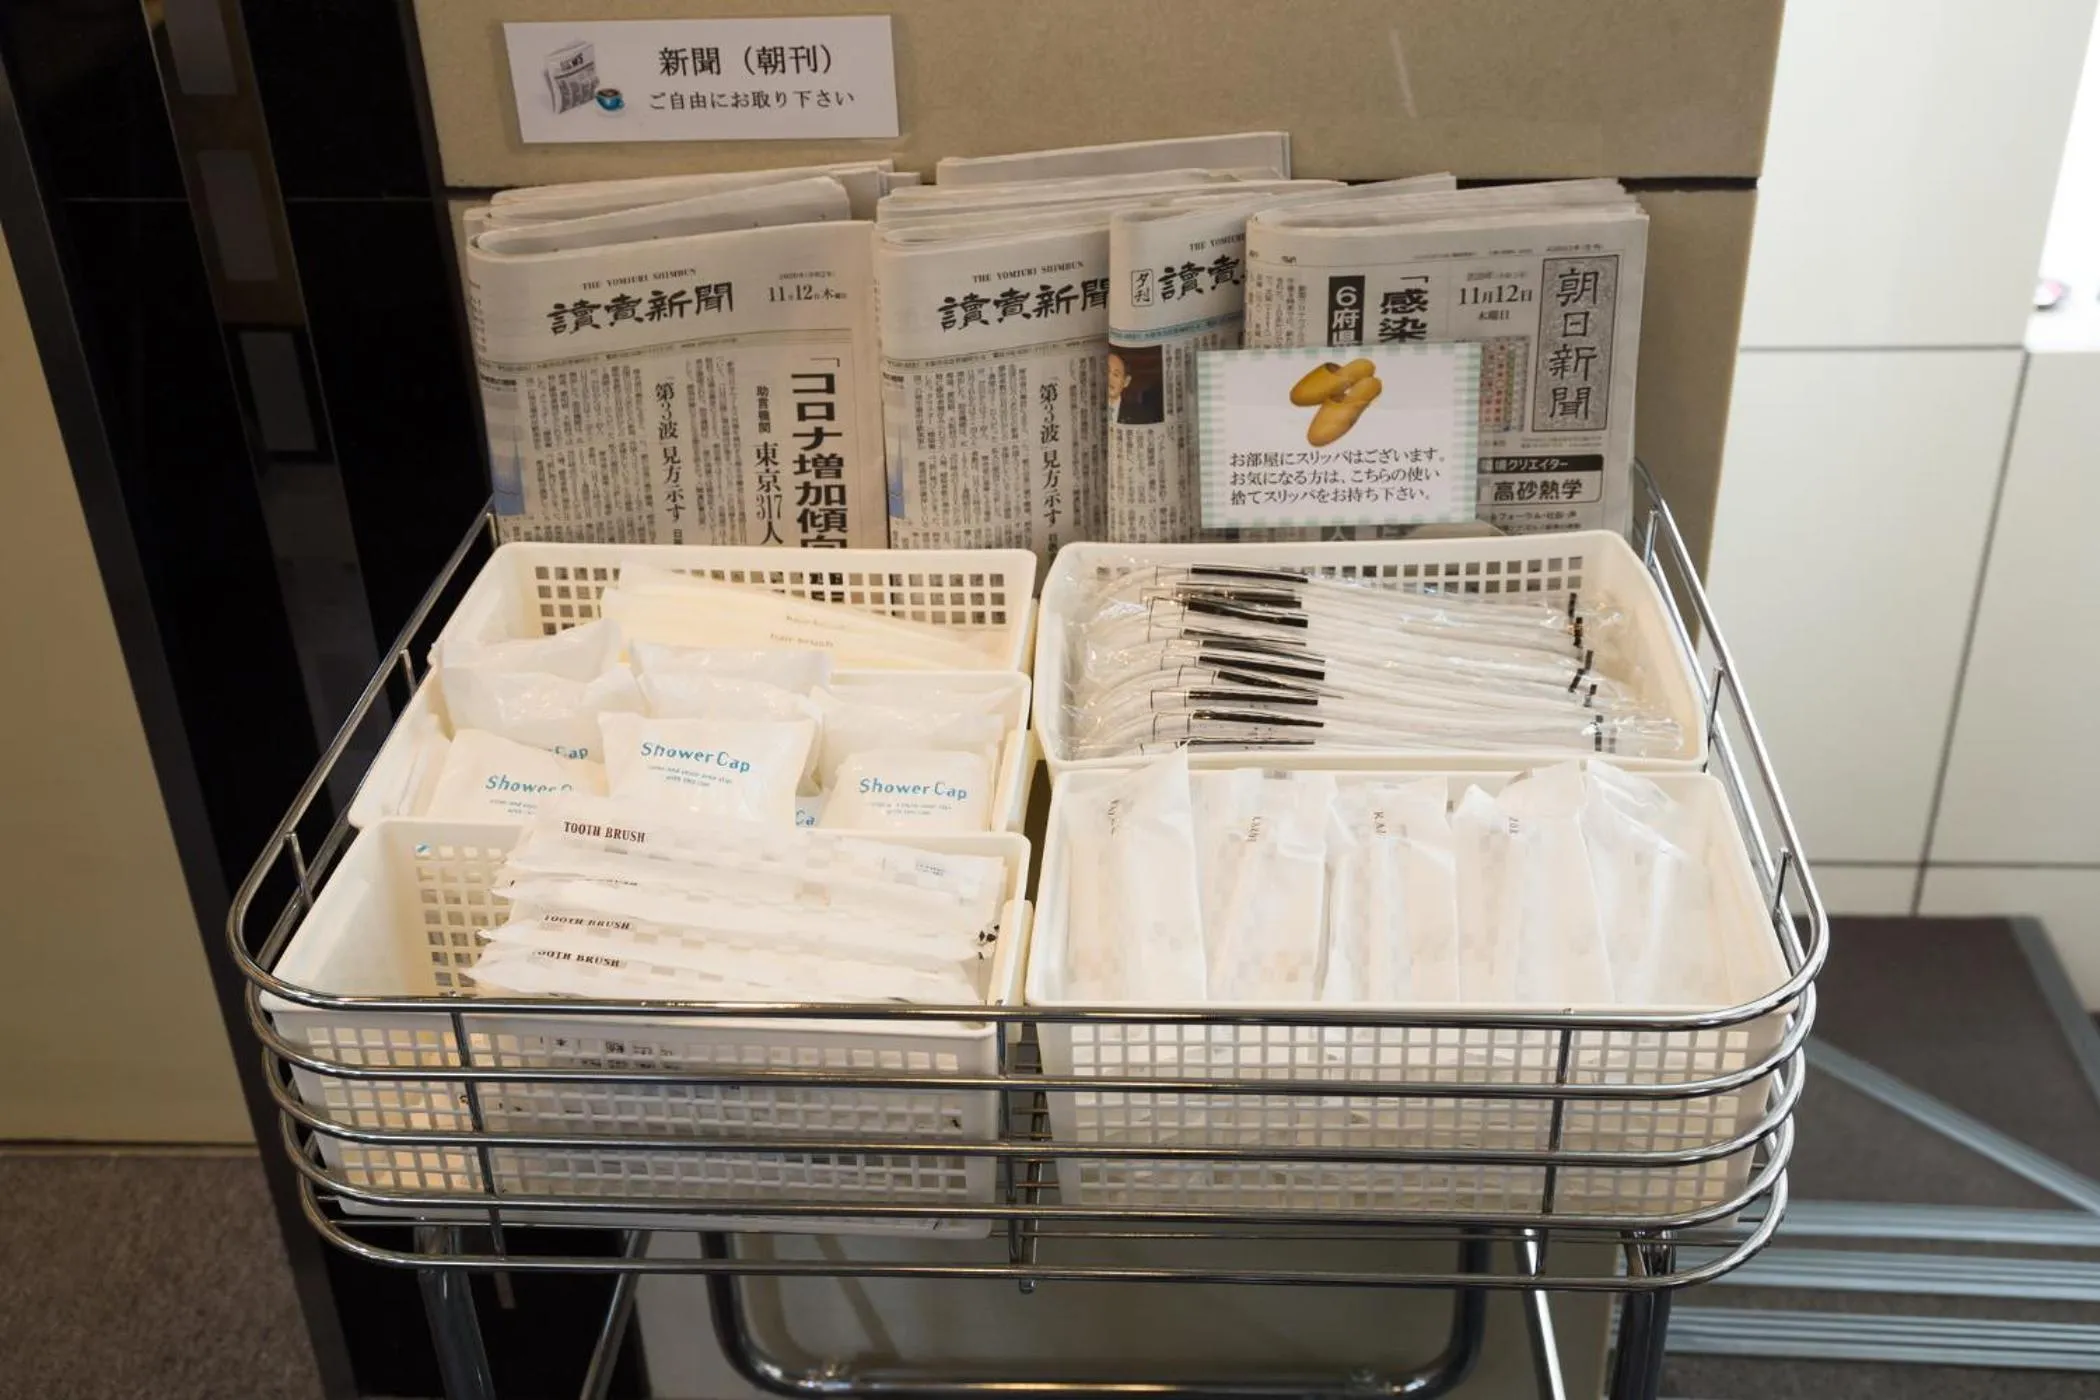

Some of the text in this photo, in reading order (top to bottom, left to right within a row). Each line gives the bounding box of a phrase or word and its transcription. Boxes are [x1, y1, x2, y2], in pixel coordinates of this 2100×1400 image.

[649, 90, 855, 110] ご自由にお取り下さい
[582, 268, 697, 291] THE YOMIURI SHIMBUN
[972, 260, 1084, 283] THE YOMIURI SHIMBUN
[1158, 254, 1245, 302] 讀賣
[1459, 284, 1533, 305] 11月12日
[1548, 268, 1599, 420] 朝日新聞
[1229, 447, 1445, 468] お部屋にスリッパはございます。
[1230, 467, 1440, 486] お気になる方は、こちらの使い
[1231, 486, 1430, 505] 捨てスリッパをお持ち下さい。
[1494, 479, 1582, 501] 高砂熱学
[640, 742, 750, 773] Shower Cap
[859, 778, 967, 801] Shower Cap
[564, 821, 646, 843] TOOTH BRUSH
[544, 914, 631, 930] TOOTH BRUSH
[576, 954, 620, 968] BRUSH
